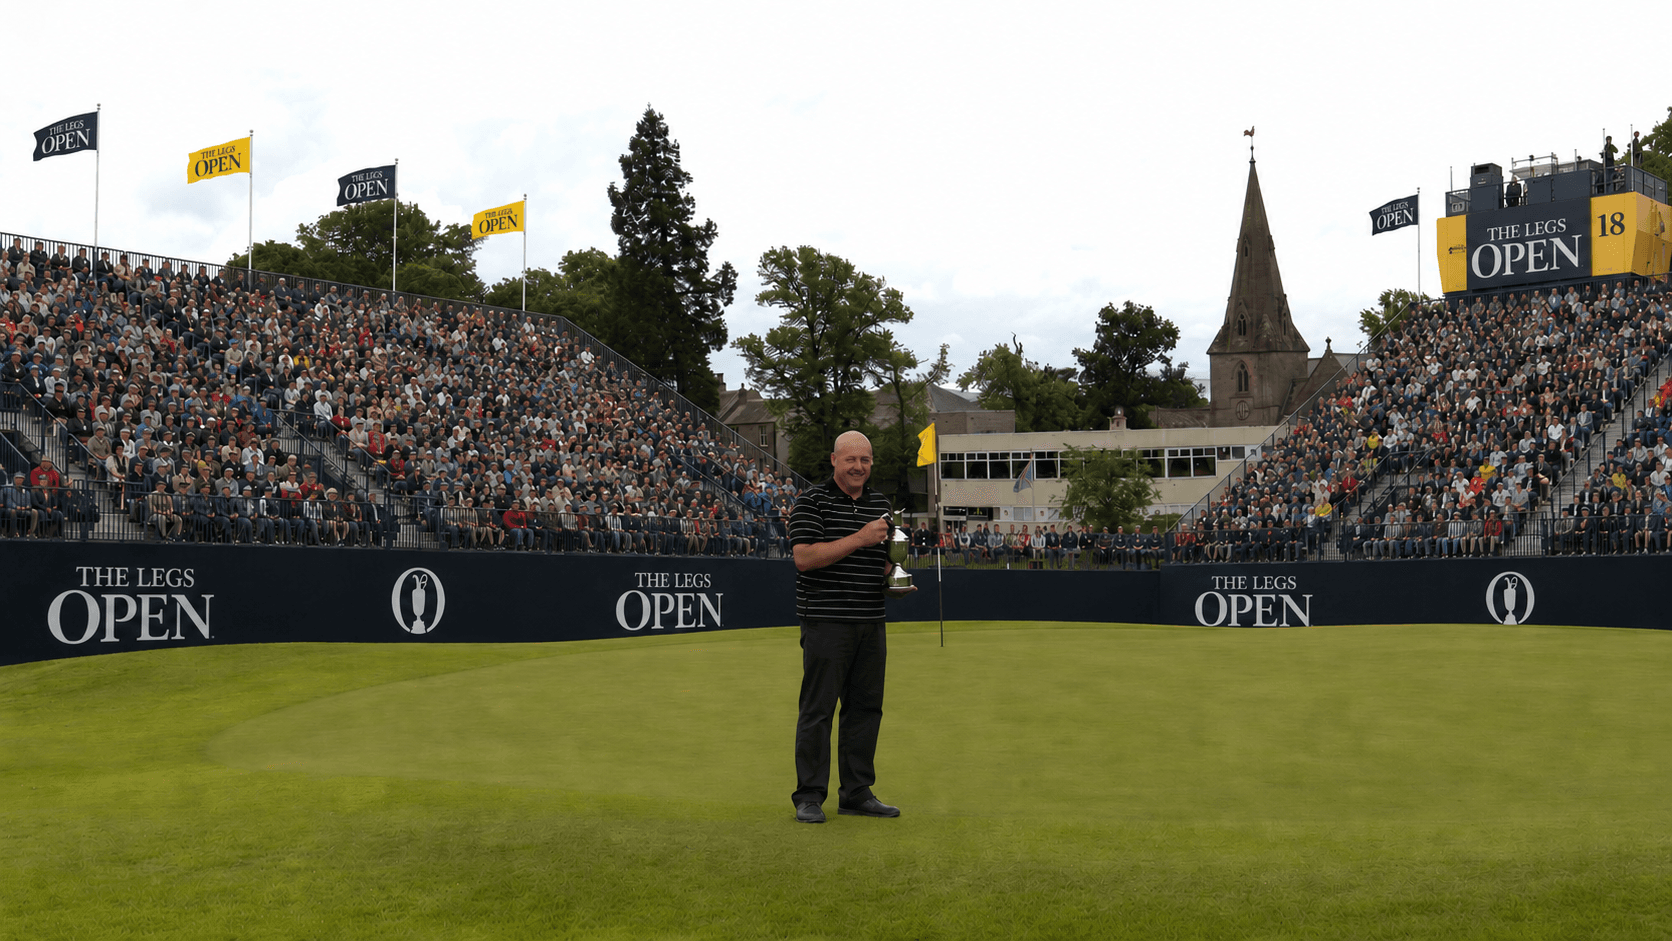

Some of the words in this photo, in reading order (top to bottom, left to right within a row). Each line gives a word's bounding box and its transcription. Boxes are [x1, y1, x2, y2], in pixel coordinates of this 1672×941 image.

[65, 120, 84, 131] LEGS
[42, 128, 90, 154] OPEN
[195, 152, 241, 177] OPEN
[345, 178, 388, 200] OPEN
[479, 214, 518, 234] OPEN
[1377, 208, 1413, 230] OPEN
[1486, 224, 1520, 241] THE
[1525, 218, 1567, 236] LEGS
[1597, 211, 1626, 238] 18
[1471, 234, 1582, 278] OPEN
[76, 566, 130, 587] THE
[136, 567, 195, 588] LEGS
[634, 572, 670, 588] THE
[674, 572, 711, 588] LEGS
[1211, 575, 1248, 590] THE
[1252, 575, 1297, 590] LEGS
[47, 589, 214, 645] OPEN
[615, 589, 724, 631] OPEN
[1194, 591, 1313, 627] OPEN
